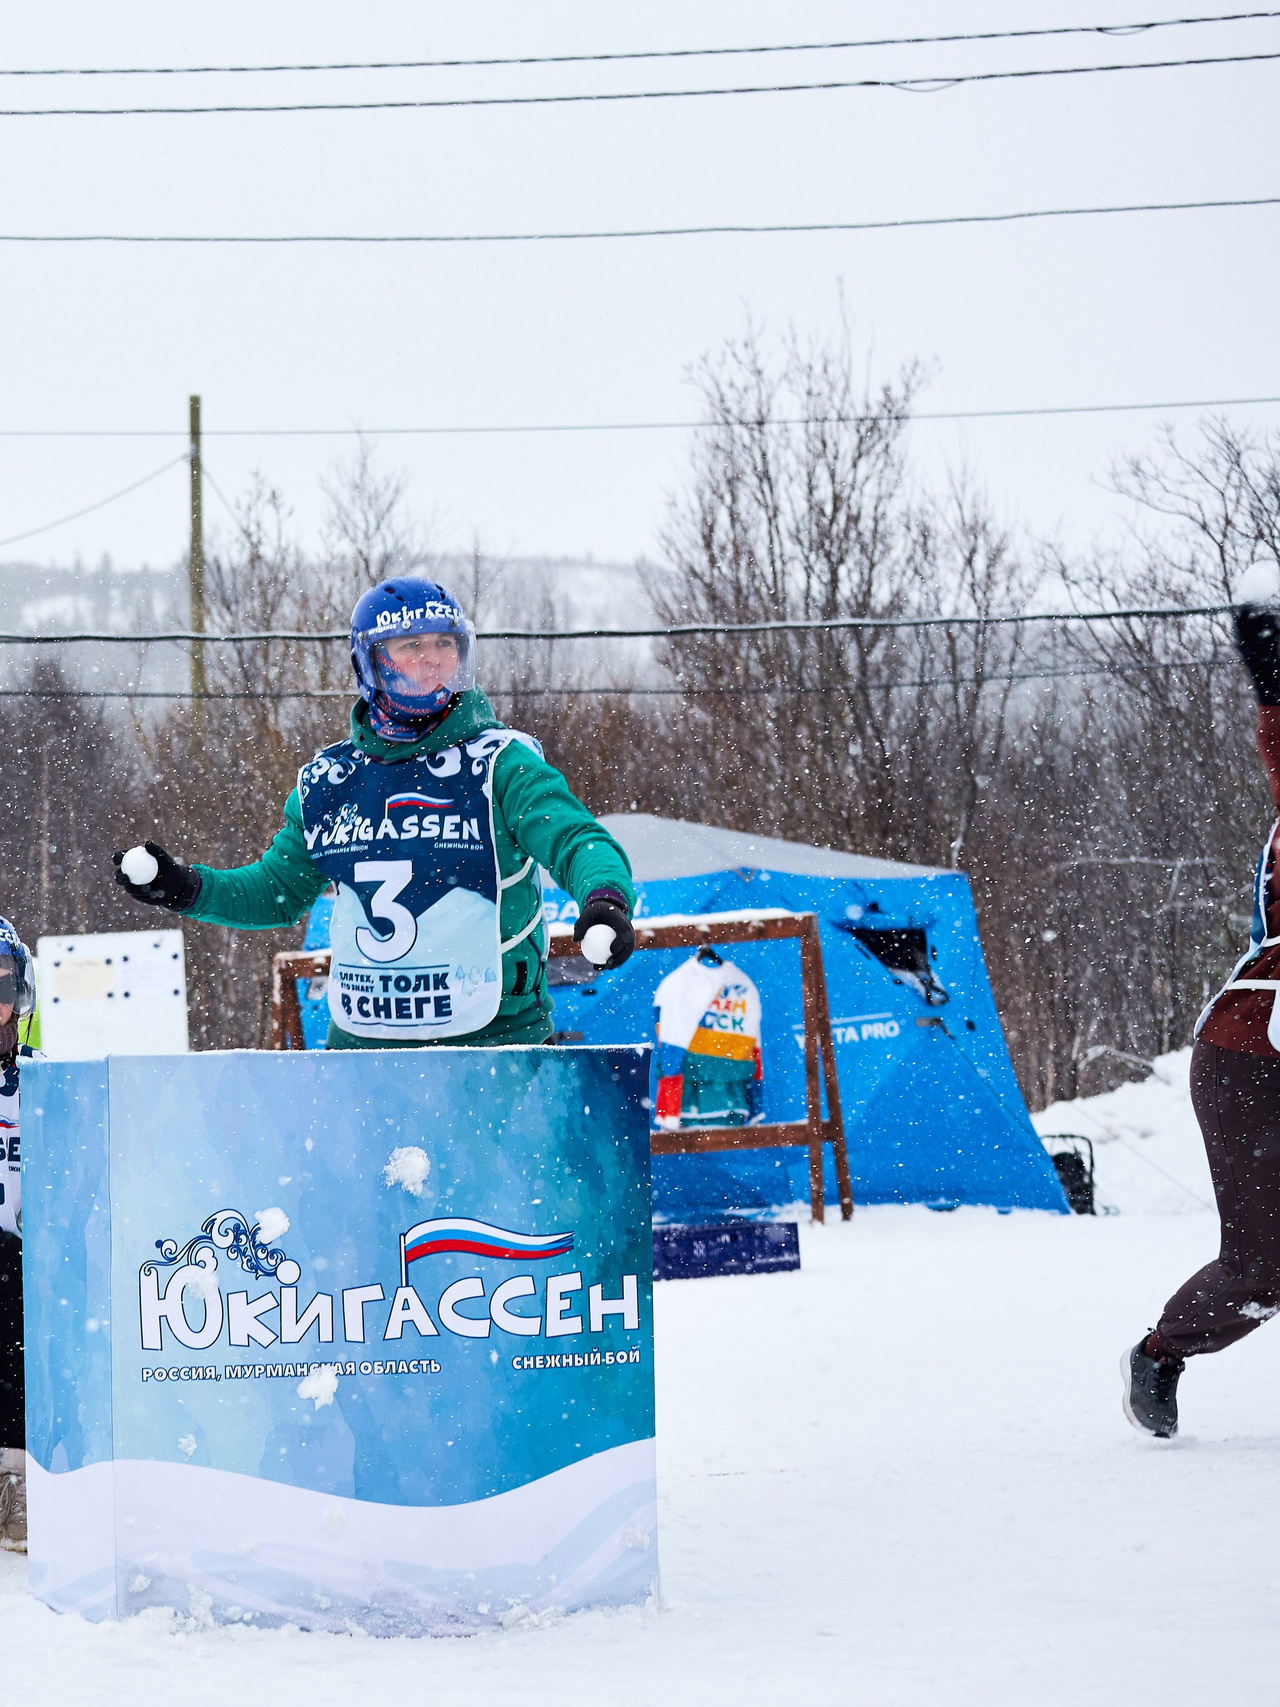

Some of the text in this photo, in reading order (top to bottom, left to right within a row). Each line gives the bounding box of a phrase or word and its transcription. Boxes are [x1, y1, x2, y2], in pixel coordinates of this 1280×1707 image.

[354, 860, 418, 962] 3
[379, 972, 450, 993] ТОЛК
[357, 995, 452, 1019] СНЕГЕ
[861, 1020, 900, 1040] PRO
[512, 1345, 640, 1370] СНЕЖНЫЙ БОЙ
[141, 1365, 222, 1382] РОССИЯ,
[359, 1360, 442, 1376] ОБЛАСТЬ
